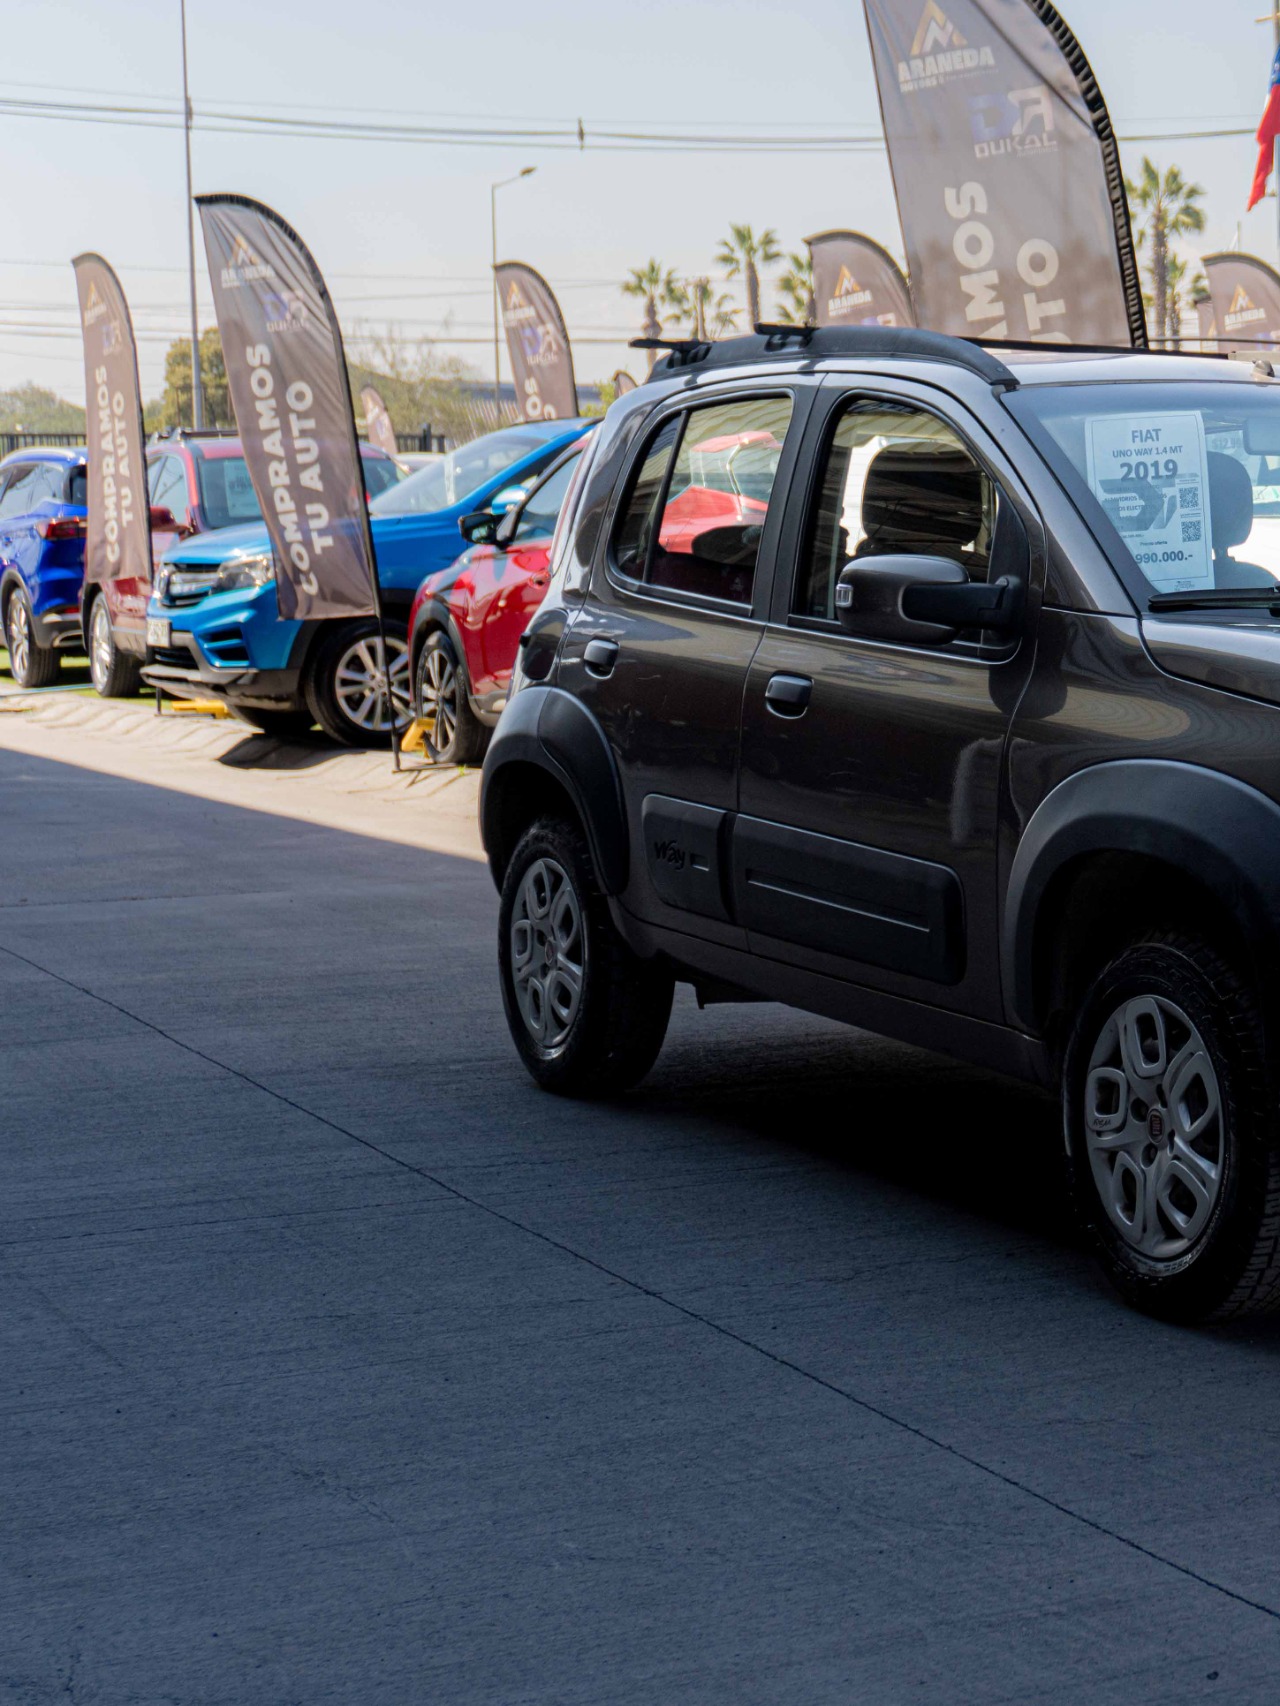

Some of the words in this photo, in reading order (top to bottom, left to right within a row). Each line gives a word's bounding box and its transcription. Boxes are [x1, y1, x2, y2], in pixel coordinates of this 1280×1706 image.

[898, 46, 995, 82] ARANEDA
[974, 133, 1056, 159] DUKAL
[112, 390, 130, 476] AUTO
[286, 380, 324, 492] AUTO
[1112, 450, 1132, 459] UNO
[1133, 448, 1153, 457] WAY
[1155, 447, 1168, 455] 1.4
[1168, 445, 1183, 454] MT
[1131, 428, 1162, 443] FIAT
[95, 365, 120, 563] COMPRAMOS
[246, 343, 319, 596] COMPRAMOS
[1119, 459, 1178, 482] 2019
[121, 486, 133, 528] TU
[305, 502, 334, 555] TU
[1135, 550, 1193, 564] 990.000.-
